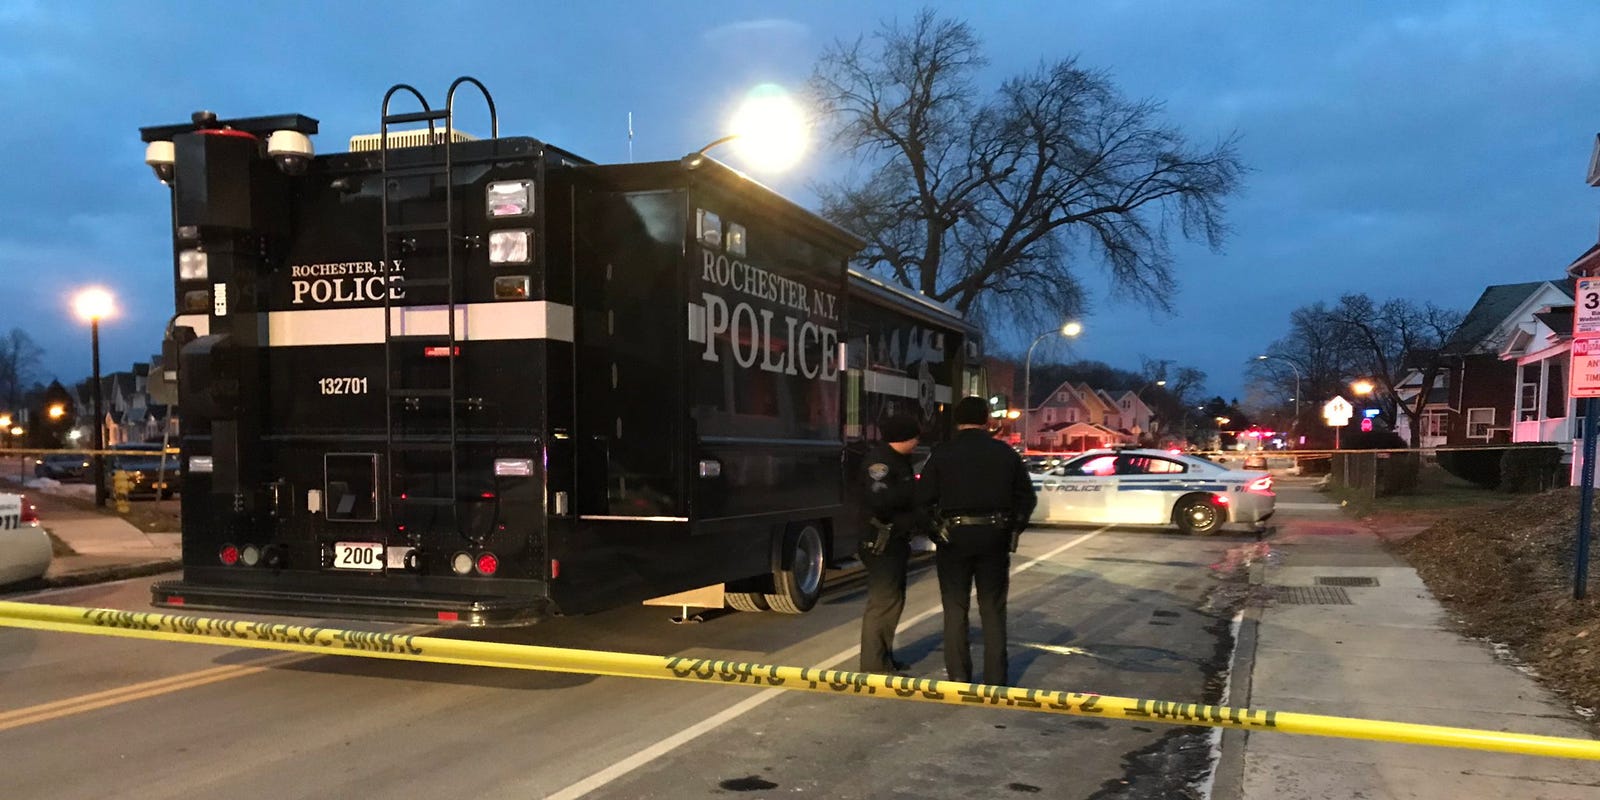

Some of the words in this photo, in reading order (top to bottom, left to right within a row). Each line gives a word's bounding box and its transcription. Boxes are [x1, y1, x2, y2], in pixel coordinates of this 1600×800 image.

[291, 261, 377, 277] ROCHESTER,
[291, 275, 406, 304] POLICE
[702, 249, 811, 317] ROCHESTER,
[813, 288, 839, 321] N.Y.
[702, 291, 838, 382] POLICE
[1574, 341, 1588, 353] NO
[1587, 360, 1600, 368] AN
[318, 377, 368, 395] 132701
[1055, 484, 1103, 492] POLICE
[343, 547, 374, 565] 200
